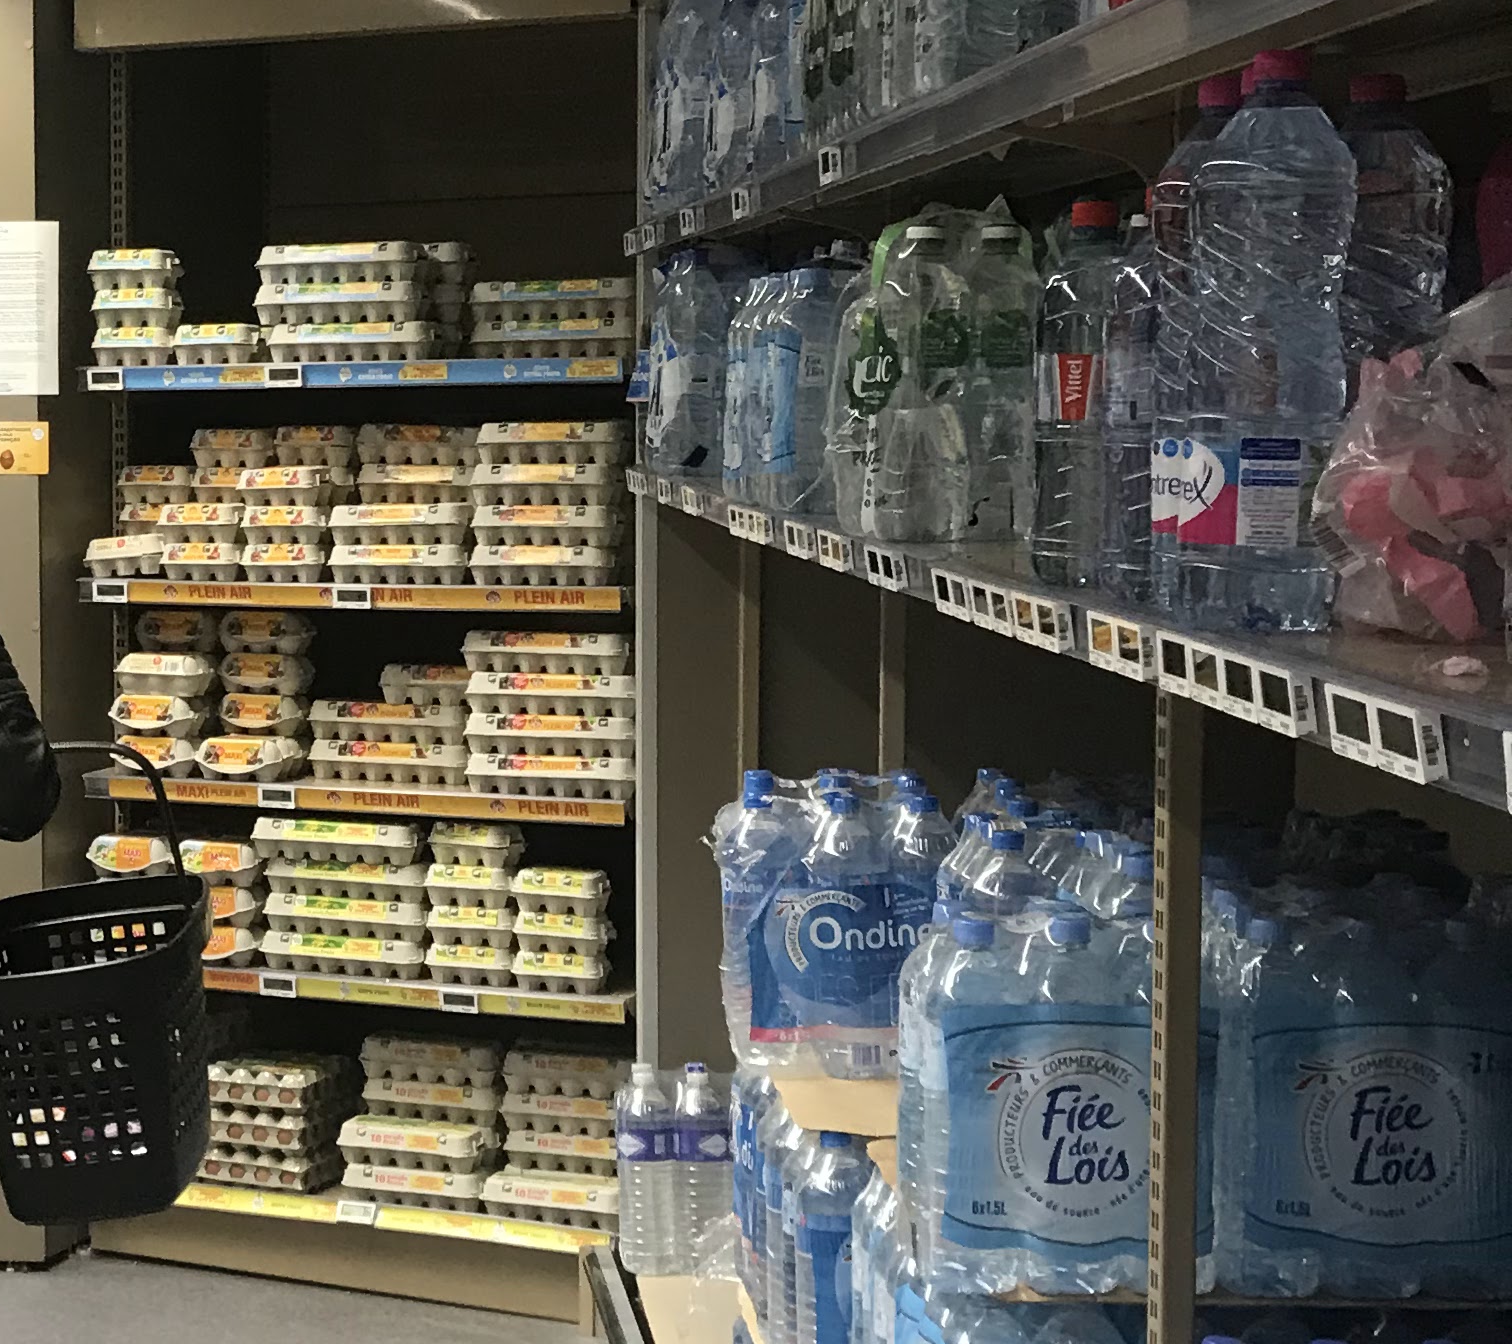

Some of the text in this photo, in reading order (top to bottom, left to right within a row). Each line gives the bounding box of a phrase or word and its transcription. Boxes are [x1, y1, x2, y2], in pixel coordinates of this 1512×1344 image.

[1064, 359, 1084, 404] Vittel
[188, 584, 252, 600] PLEIN AIR
[390, 588, 413, 602] AIR
[514, 590, 586, 605] PLEIN AIR
[176, 784, 209, 799] MAXI
[353, 791, 420, 808] PLEIN AIR
[518, 799, 589, 817] PLEIN AIR
[1003, 1086, 1029, 1180] PRODUCTEURS
[1042, 1055, 1134, 1085] COMMERÇANTS
[1041, 1084, 1126, 1141] Fiée
[1308, 1087, 1336, 1181] PRODUCTEURS
[1350, 1056, 1441, 1085] COMMERÇANTS
[1350, 1085, 1434, 1141] Fiée
[1069, 1134, 1099, 1156] des
[1376, 1135, 1406, 1157] des
[1044, 1136, 1130, 1185] Lois
[1350, 1136, 1437, 1186] Lois
